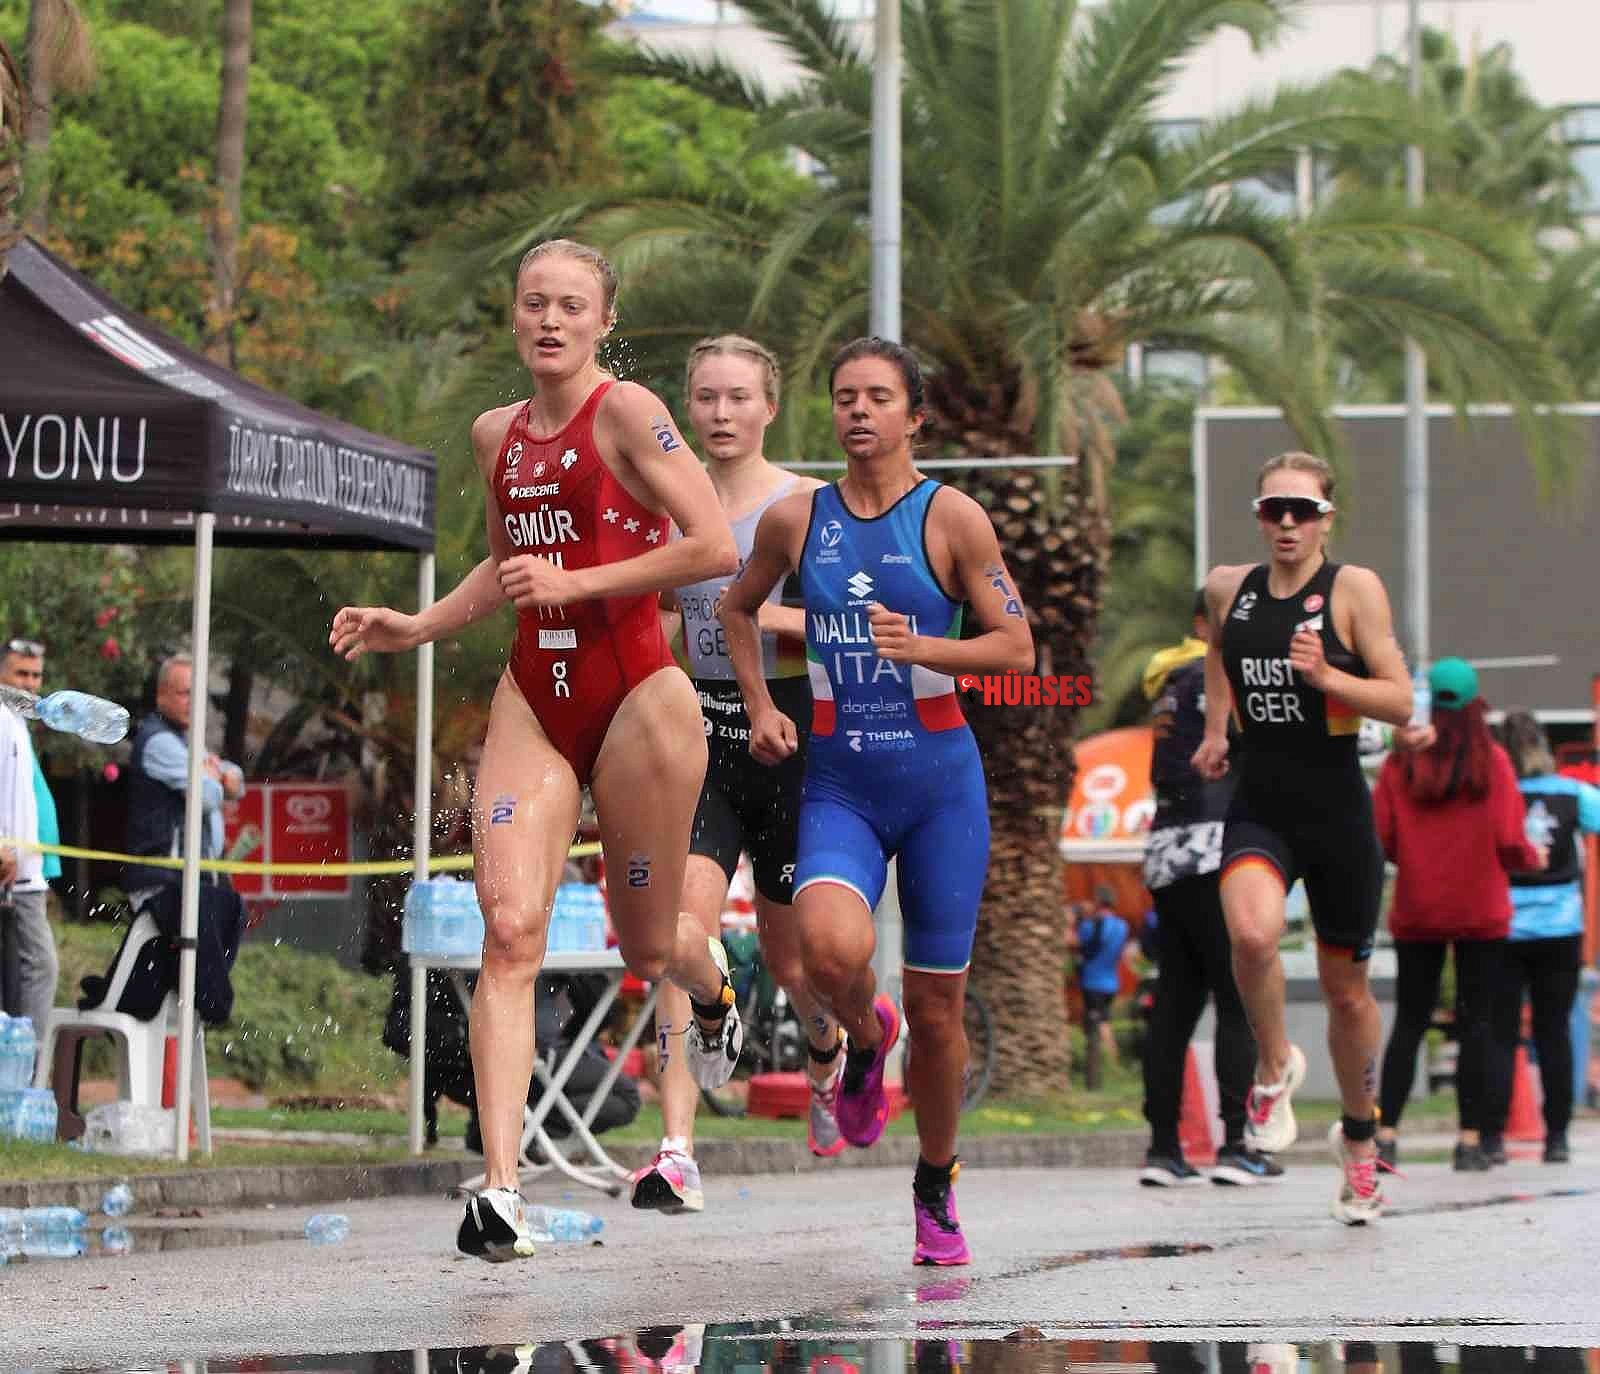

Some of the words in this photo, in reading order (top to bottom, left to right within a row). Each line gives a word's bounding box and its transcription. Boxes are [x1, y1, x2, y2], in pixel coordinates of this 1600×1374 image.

[0, 413, 147, 482] YONU
[518, 483, 560, 499] DESCENTE
[504, 503, 581, 547] GMÜR
[697, 628, 728, 657] GE
[812, 612, 918, 644] MALLI
[834, 651, 902, 684] ITA
[1241, 658, 1295, 687] RUST
[842, 697, 906, 714] dorelan
[1246, 691, 1305, 723] GER
[866, 730, 915, 742] THEMA
